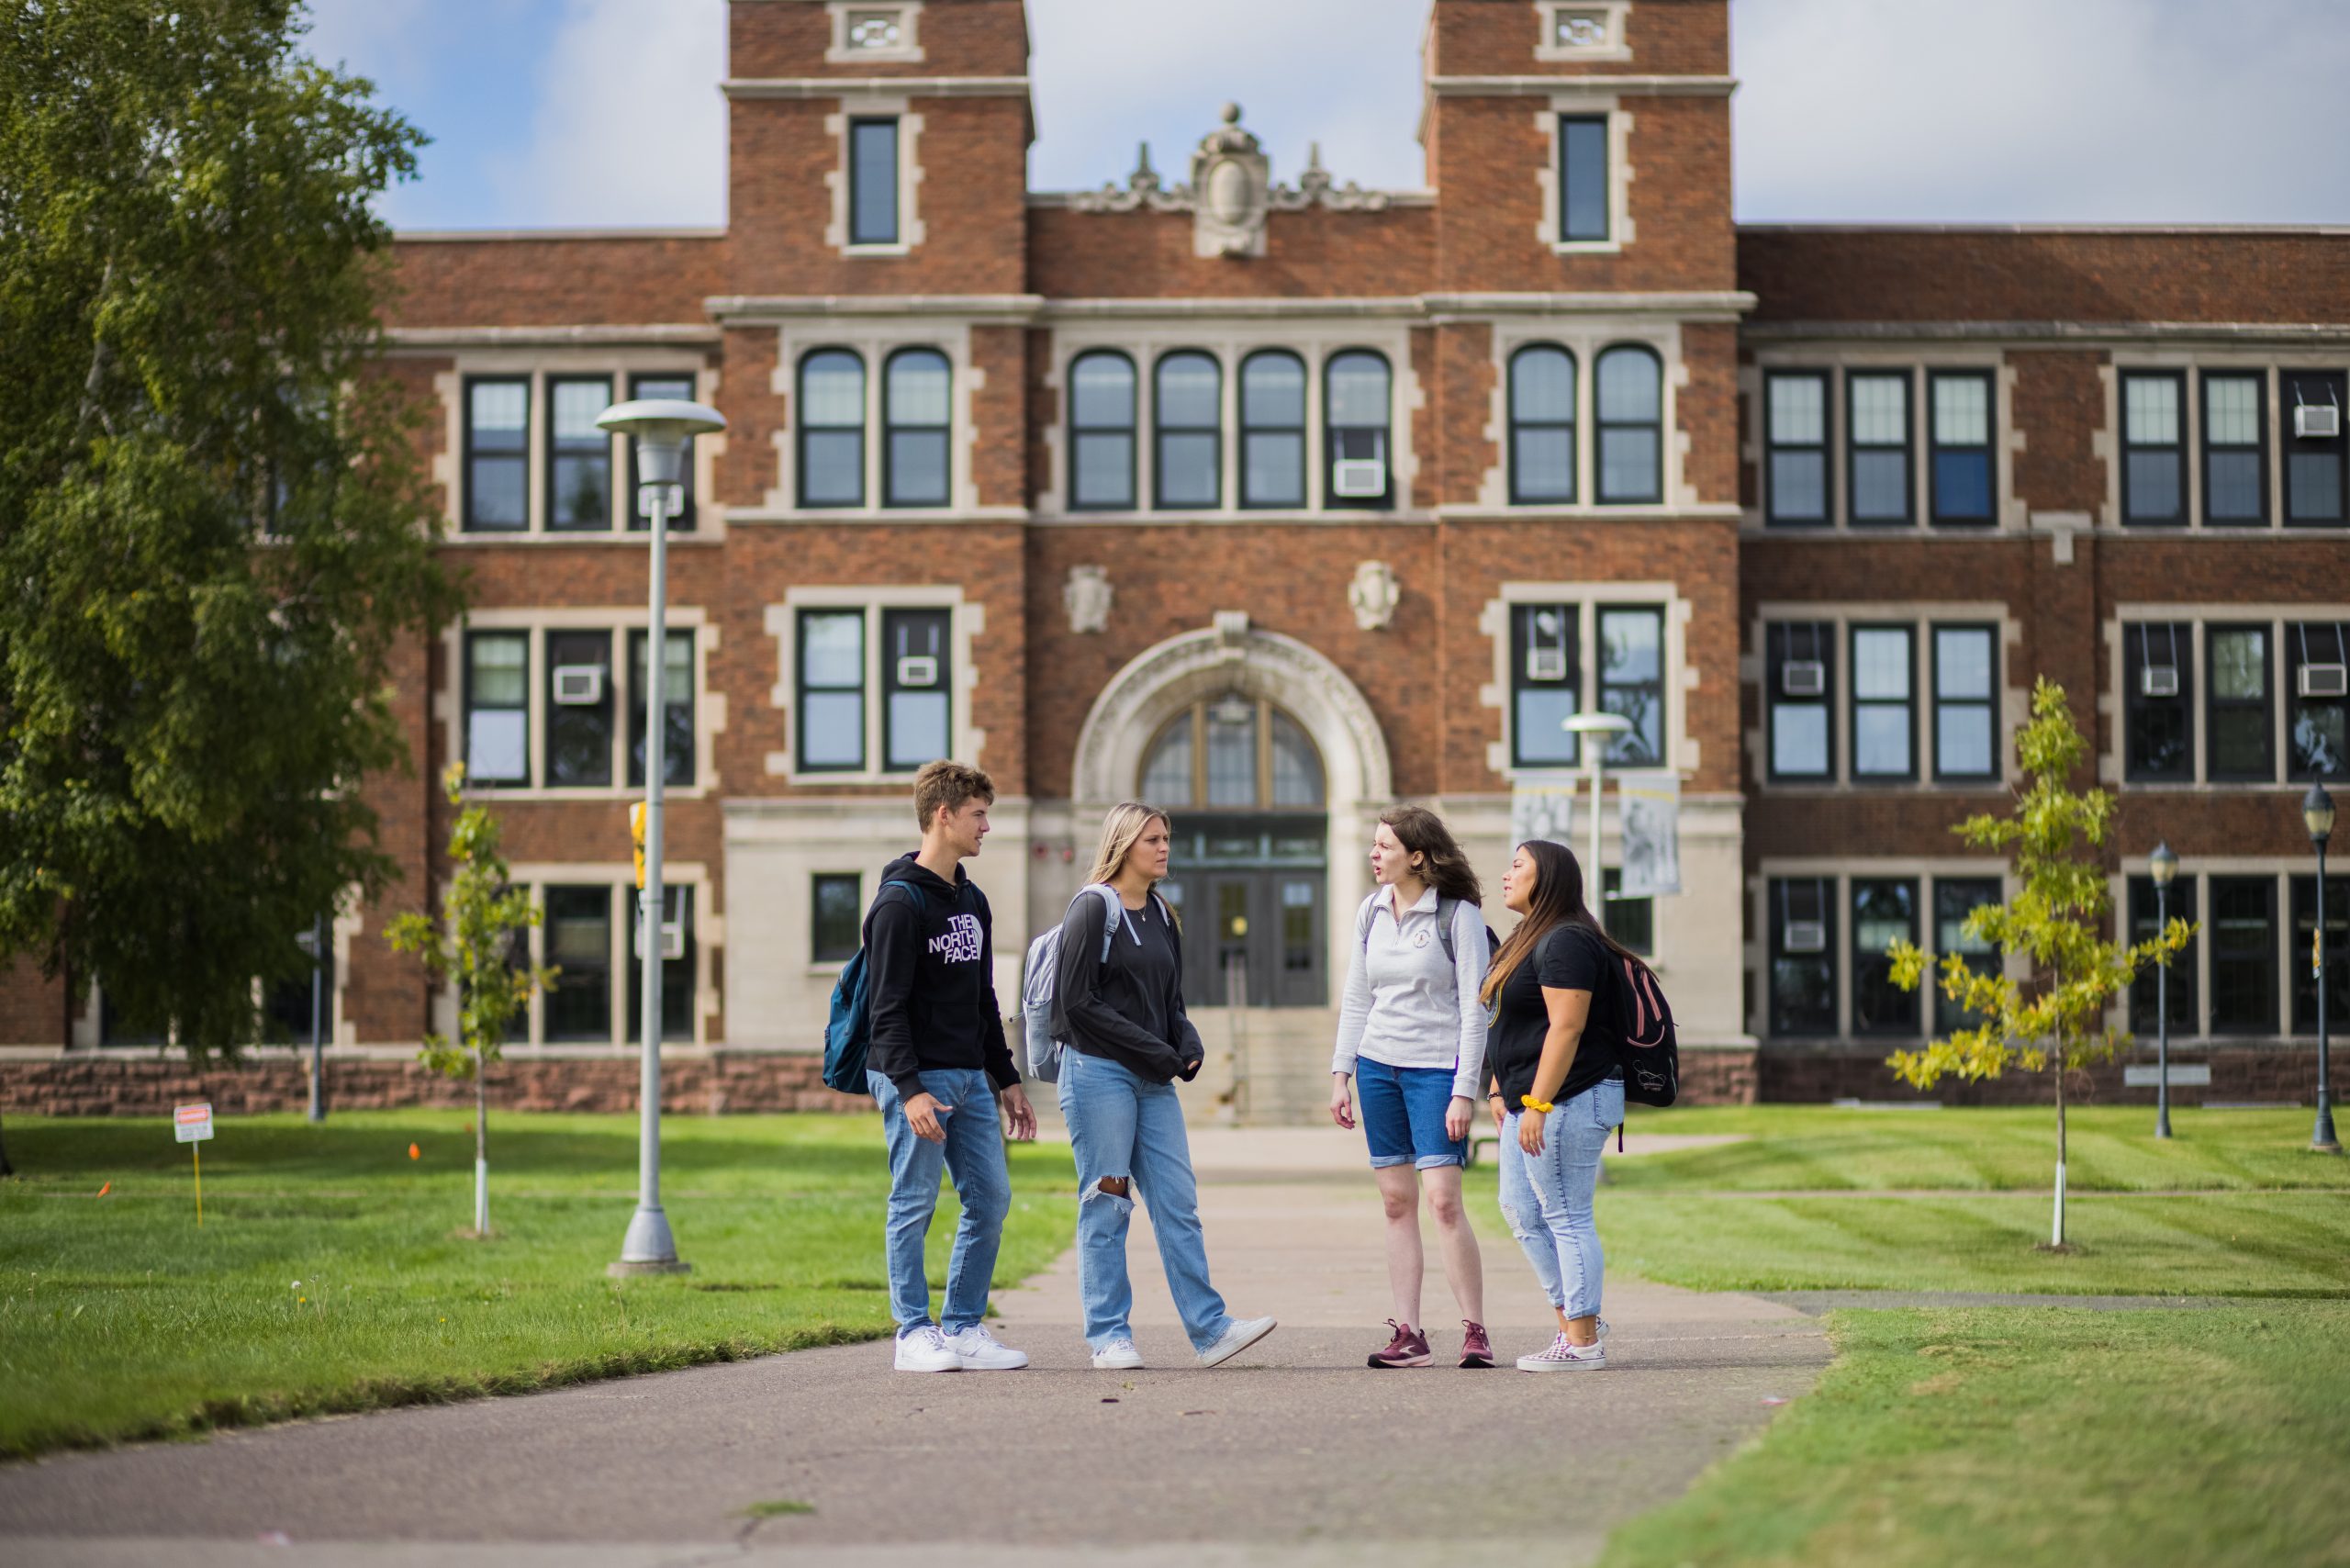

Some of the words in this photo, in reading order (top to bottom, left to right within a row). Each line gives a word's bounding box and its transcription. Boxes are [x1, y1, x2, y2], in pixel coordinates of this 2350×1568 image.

[947, 914, 972, 931] THE
[929, 929, 976, 953] NORTH
[945, 945, 978, 964] FACE
